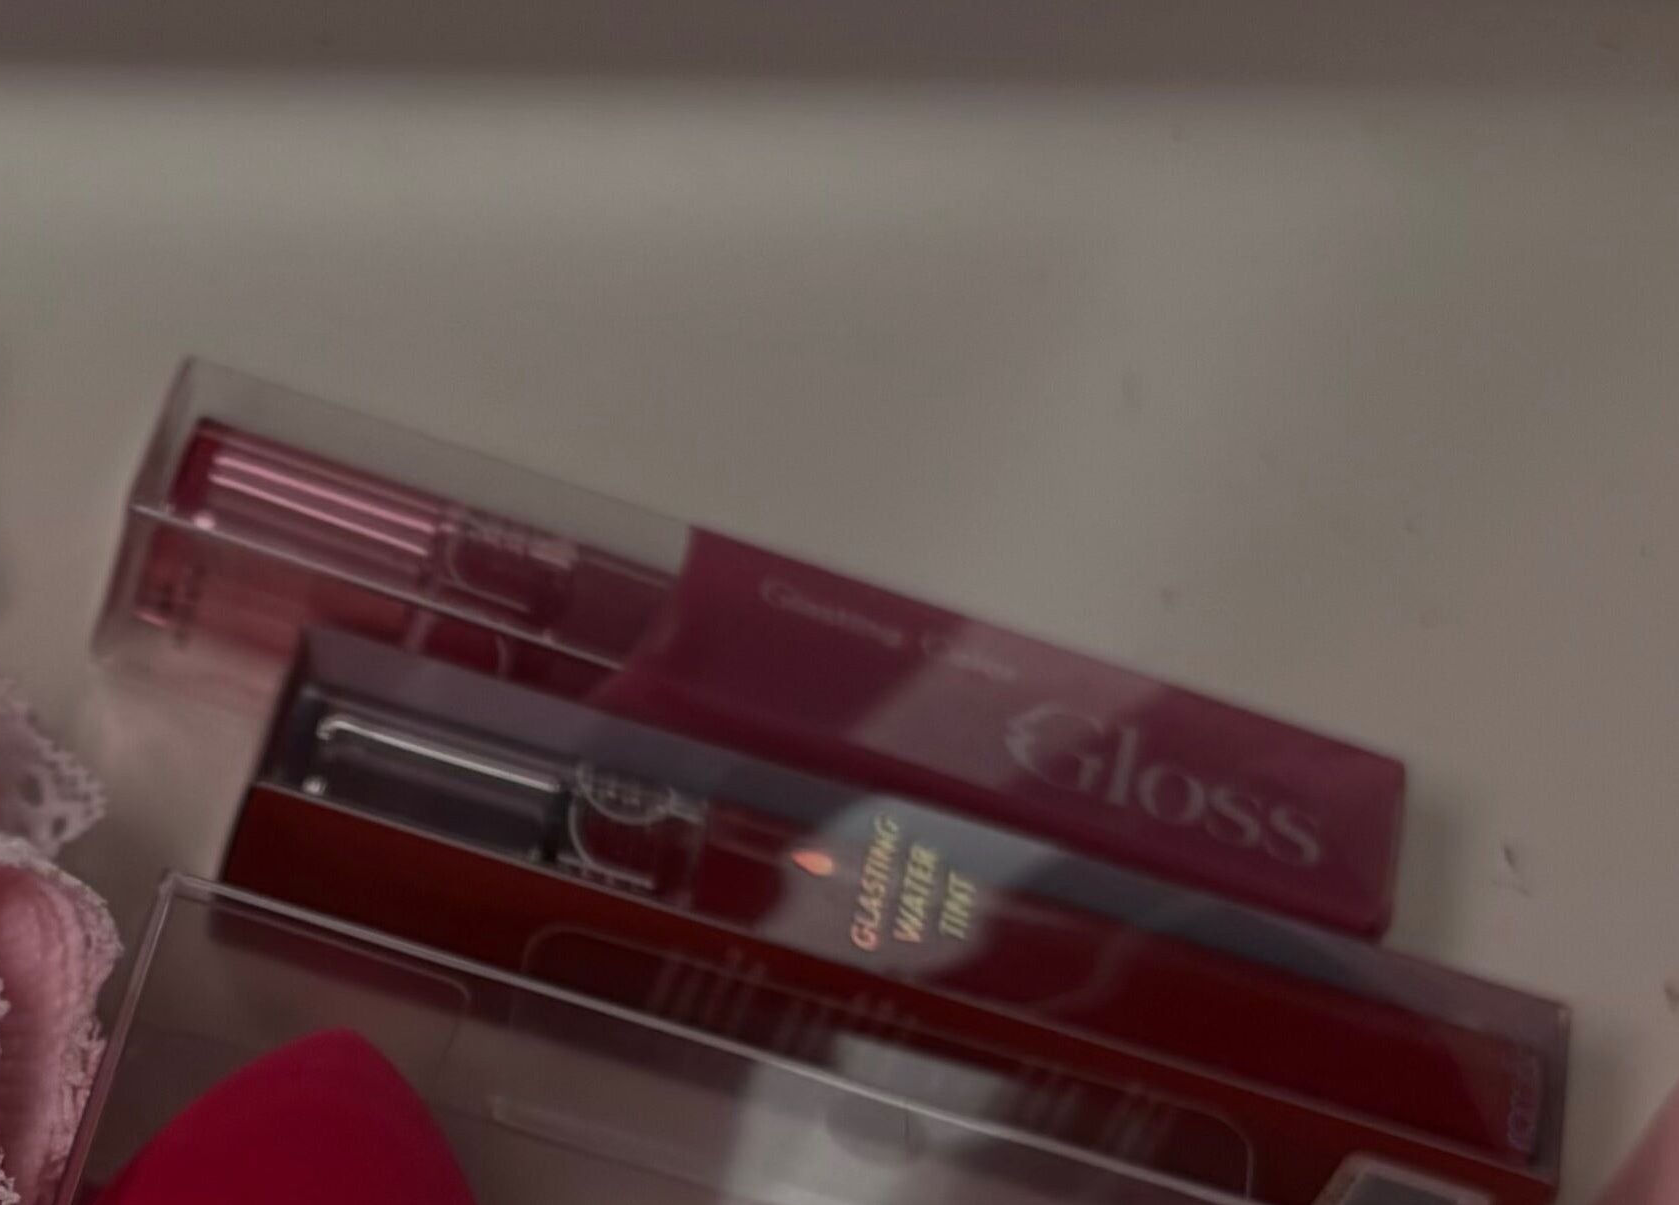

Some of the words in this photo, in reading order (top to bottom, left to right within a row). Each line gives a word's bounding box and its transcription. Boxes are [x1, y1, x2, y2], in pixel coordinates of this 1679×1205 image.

[1005, 702, 1321, 867] Gloss
[850, 813, 901, 952] GLASTING
[892, 845, 940, 943] WATER
[938, 869, 977, 940] TINT
